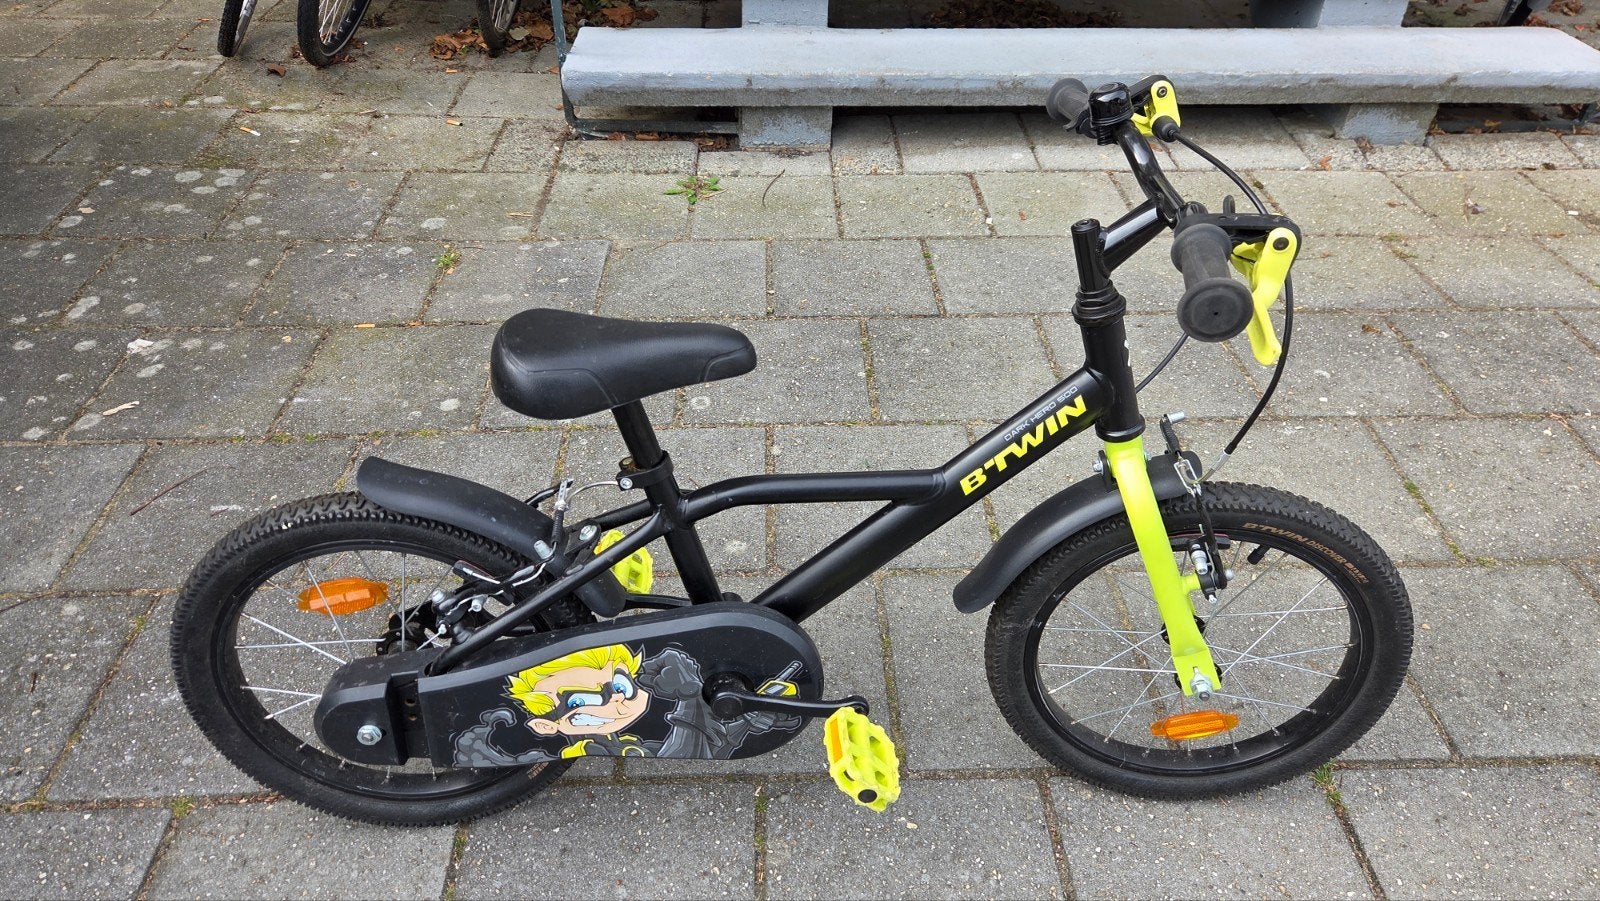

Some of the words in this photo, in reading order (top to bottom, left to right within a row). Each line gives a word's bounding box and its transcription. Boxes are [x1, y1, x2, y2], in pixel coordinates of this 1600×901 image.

[1003, 421, 1031, 442] DARK
[1031, 402, 1057, 423] HERO
[1057, 386, 1078, 403] 500
[959, 394, 1087, 496] B'TWIN
[1307, 539, 1347, 565] DISCOVER
